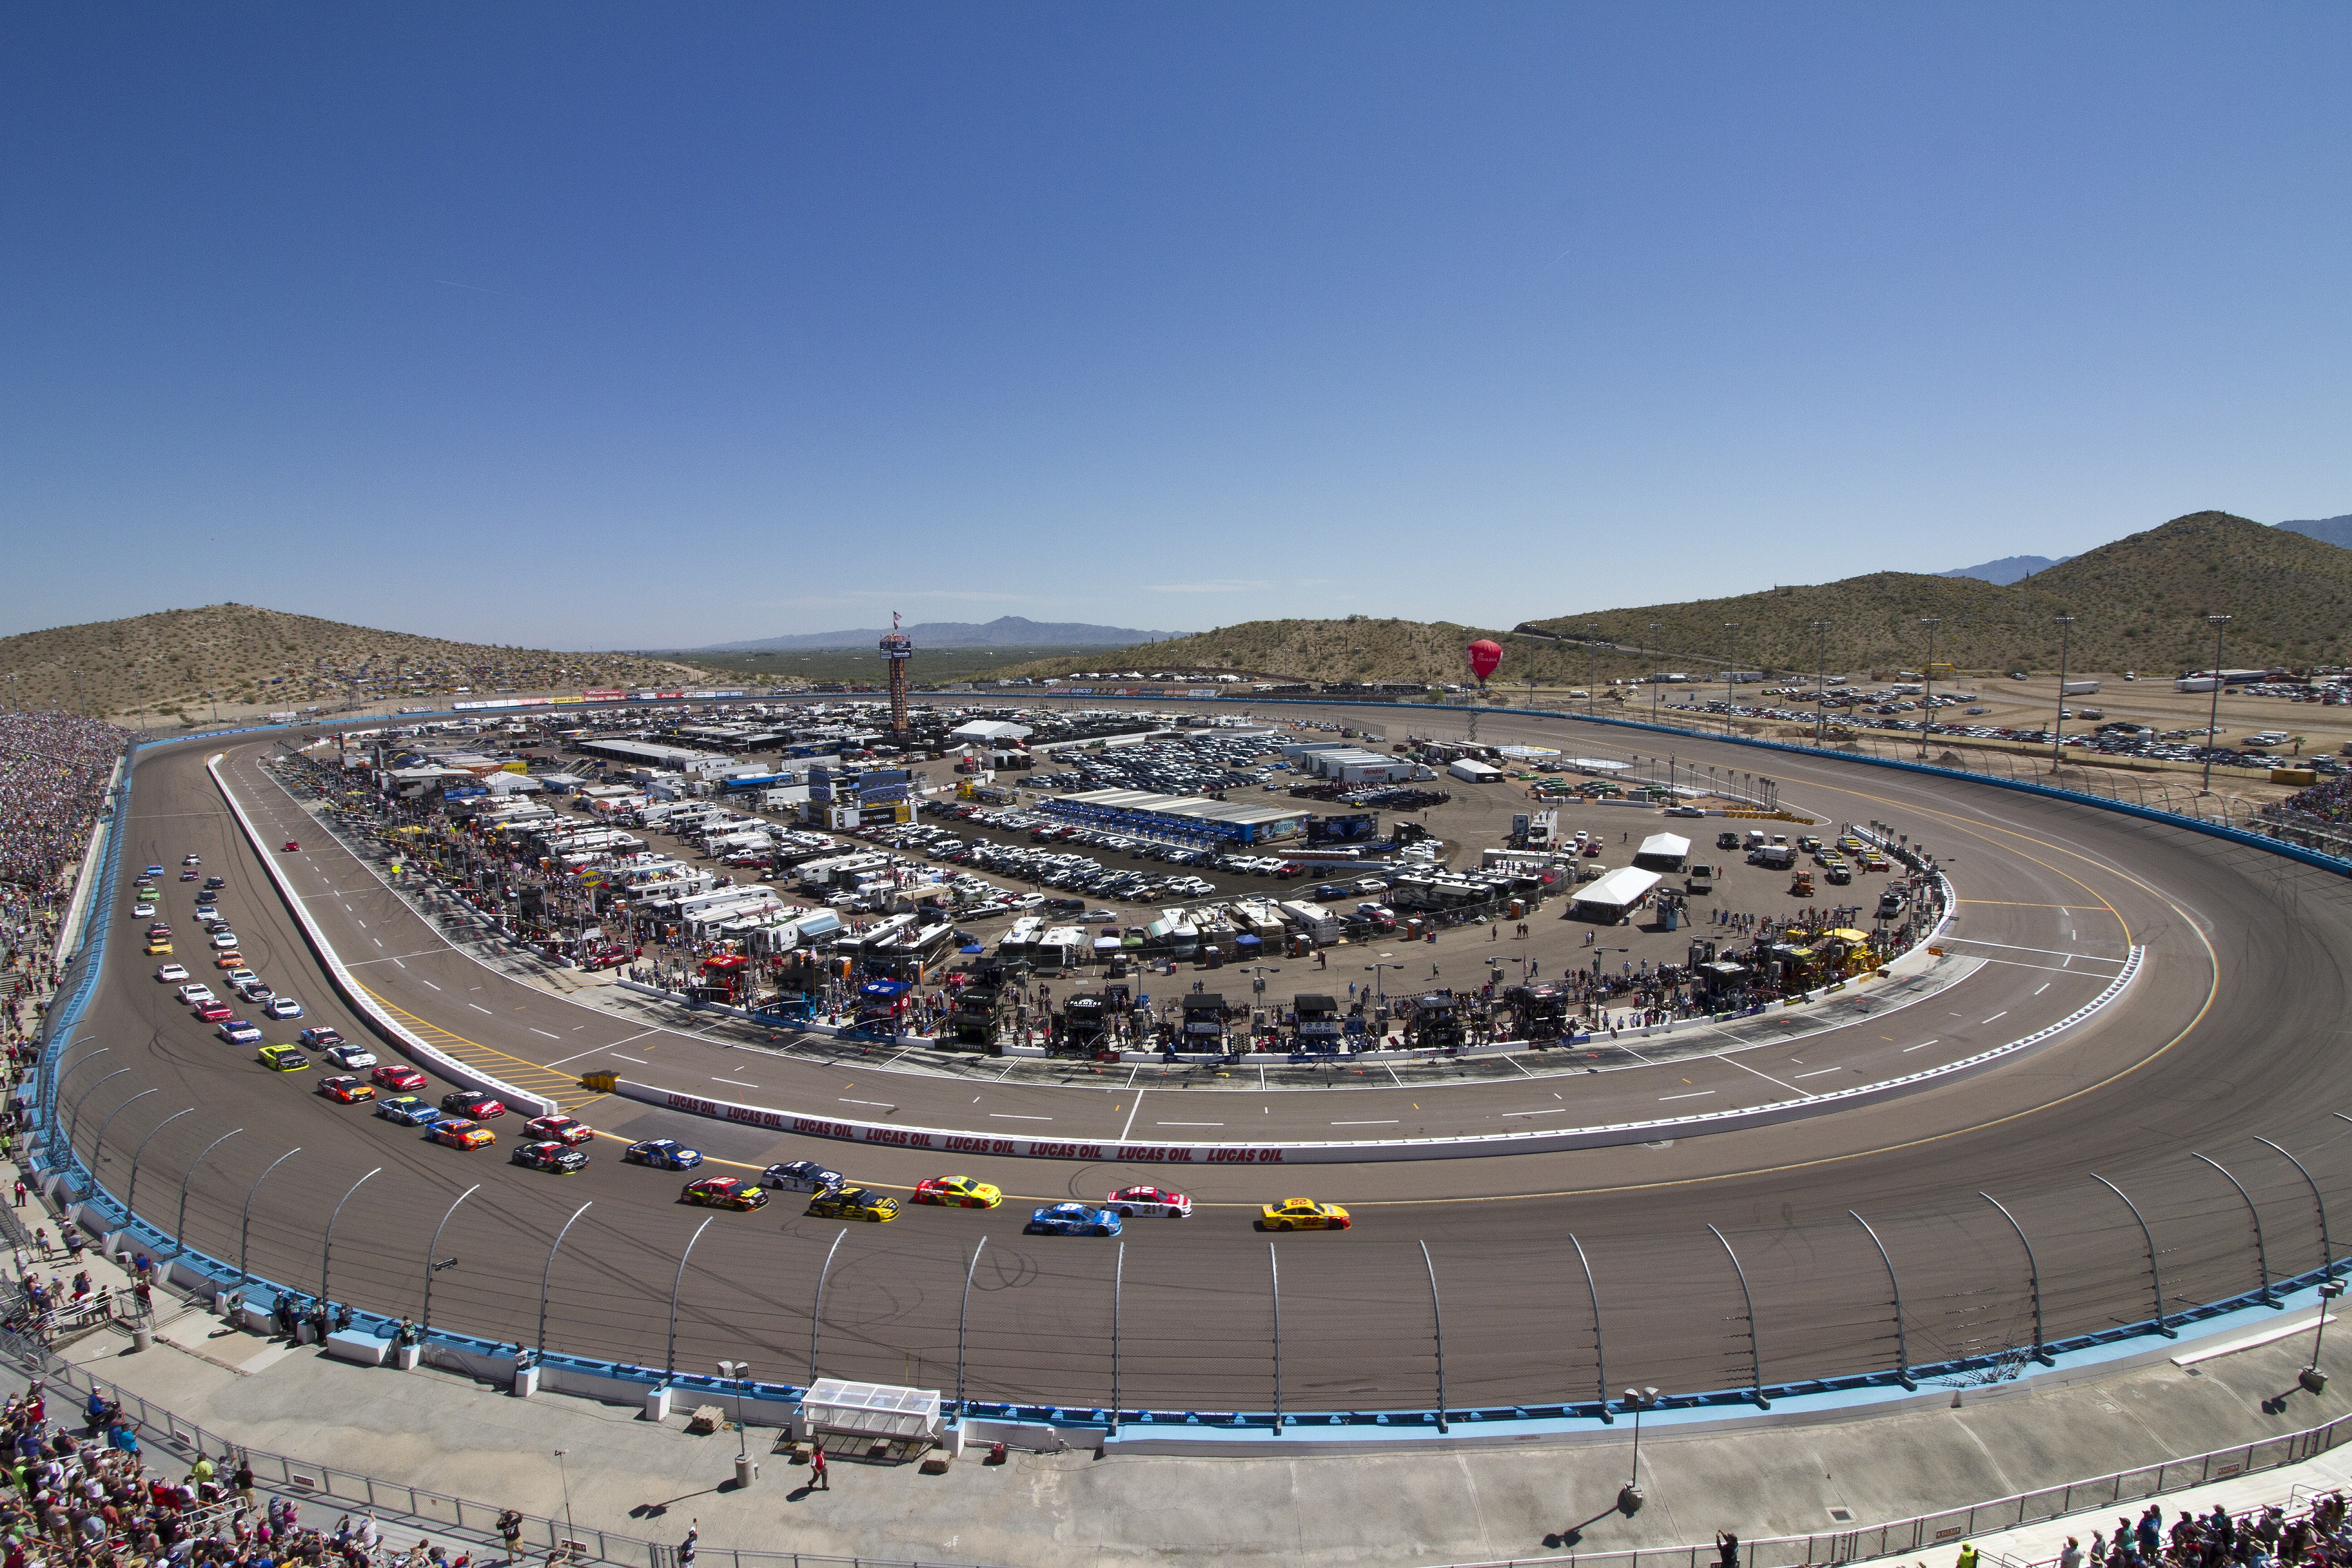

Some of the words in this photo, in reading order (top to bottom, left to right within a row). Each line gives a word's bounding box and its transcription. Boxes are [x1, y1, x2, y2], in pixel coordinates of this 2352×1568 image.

[1276, 822, 1293, 833] Airgas
[572, 872, 611, 884] SUNOCO
[715, 1005, 731, 1014] Cessna
[668, 1094, 698, 1111] LUCAS
[701, 1103, 717, 1115] OIL
[727, 1106, 762, 1123] LUCAS
[763, 1113, 782, 1128] OIL
[793, 1118, 831, 1135] LUCAS
[834, 1125, 854, 1138] OIL
[866, 1129, 907, 1145] LUCAS
[910, 1134, 932, 1147] OIL
[945, 1136, 989, 1152] LUCAS
[992, 1140, 1016, 1154] OIL
[1029, 1143, 1076, 1158] LUCAS
[1079, 1145, 1103, 1159] OIL
[651, 1155, 661, 1165] 24
[1117, 1146, 1166, 1161] LUCAS
[1168, 1148, 1193, 1162] OIL
[1206, 1148, 1256, 1163] LUCAS
[1259, 1149, 1284, 1163] OIL
[710, 1195, 726, 1204] 77
[1143, 1205, 1156, 1214] 21
[1067, 1223, 1082, 1232] 42
[1303, 1217, 1319, 1226] 22
